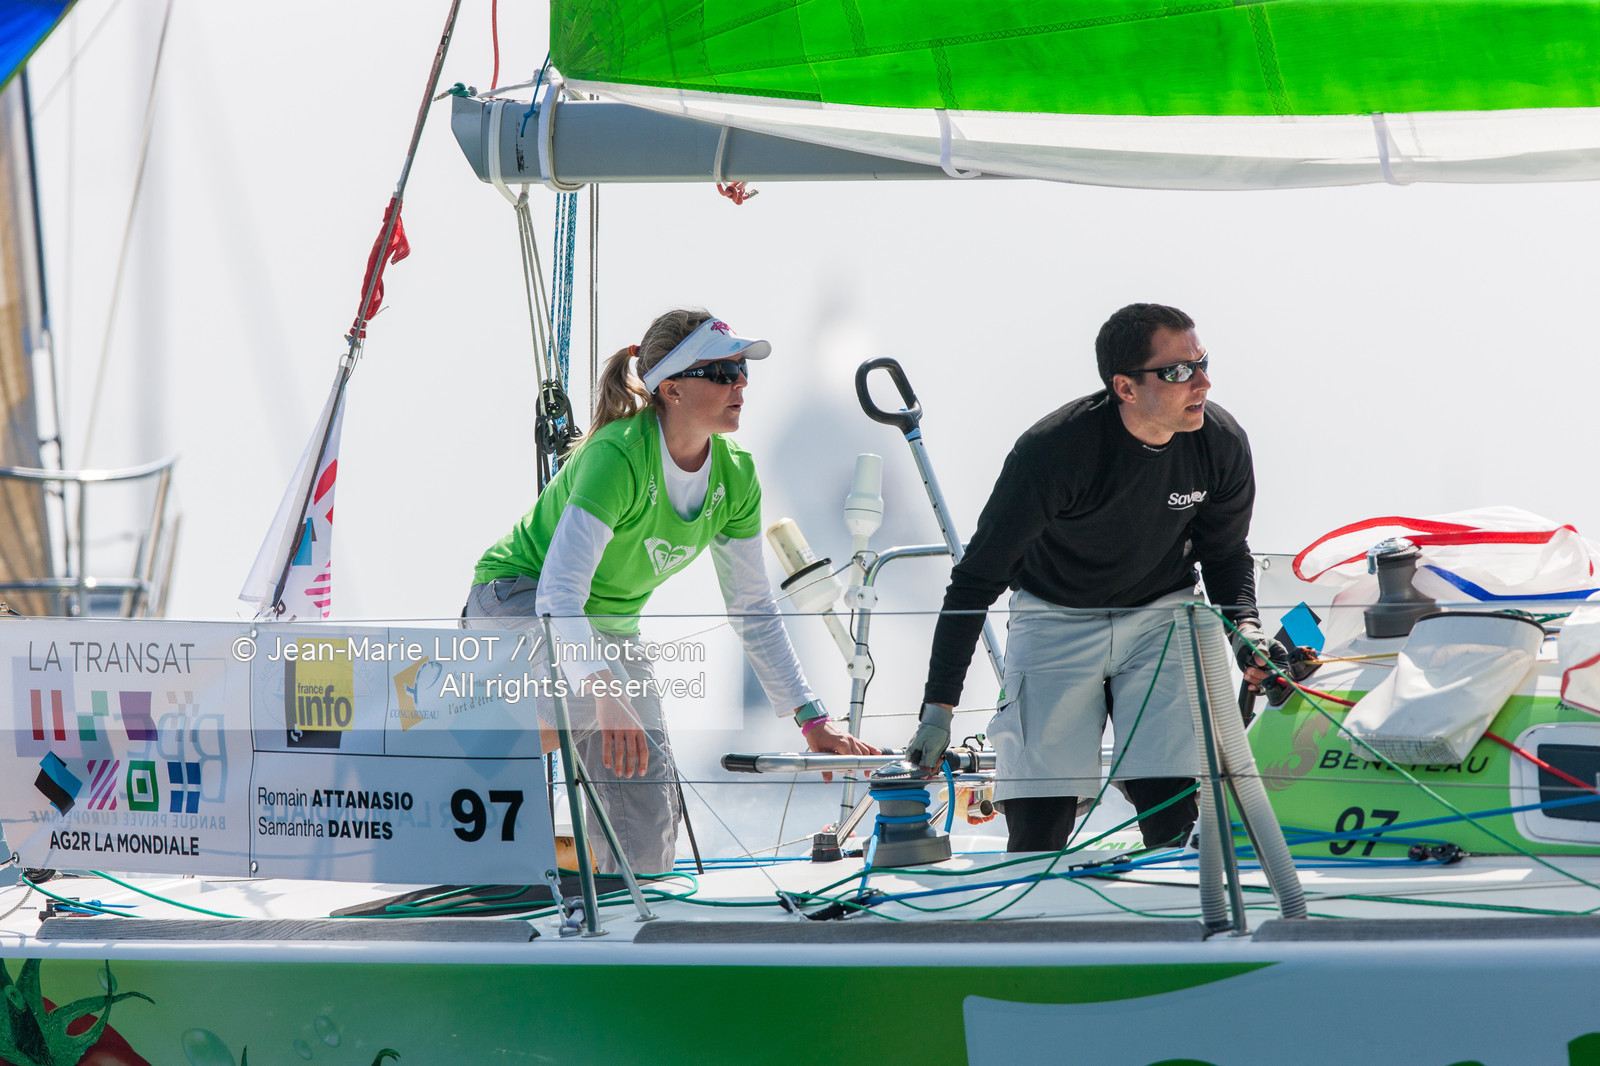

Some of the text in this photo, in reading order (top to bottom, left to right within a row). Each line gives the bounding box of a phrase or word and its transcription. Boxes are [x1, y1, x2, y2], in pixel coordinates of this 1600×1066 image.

[28, 641, 196, 674] LA TRANSAT
[297, 682, 324, 696] france
[297, 685, 353, 728] info
[389, 708, 440, 721] CONCARNEAU
[257, 787, 414, 811] Romain ATTANASIO
[257, 817, 394, 841] Samantha DAVIES
[450, 788, 525, 843] 97
[49, 830, 200, 857] AG2R LA MONDIALE
[1328, 806, 1401, 857] 97
